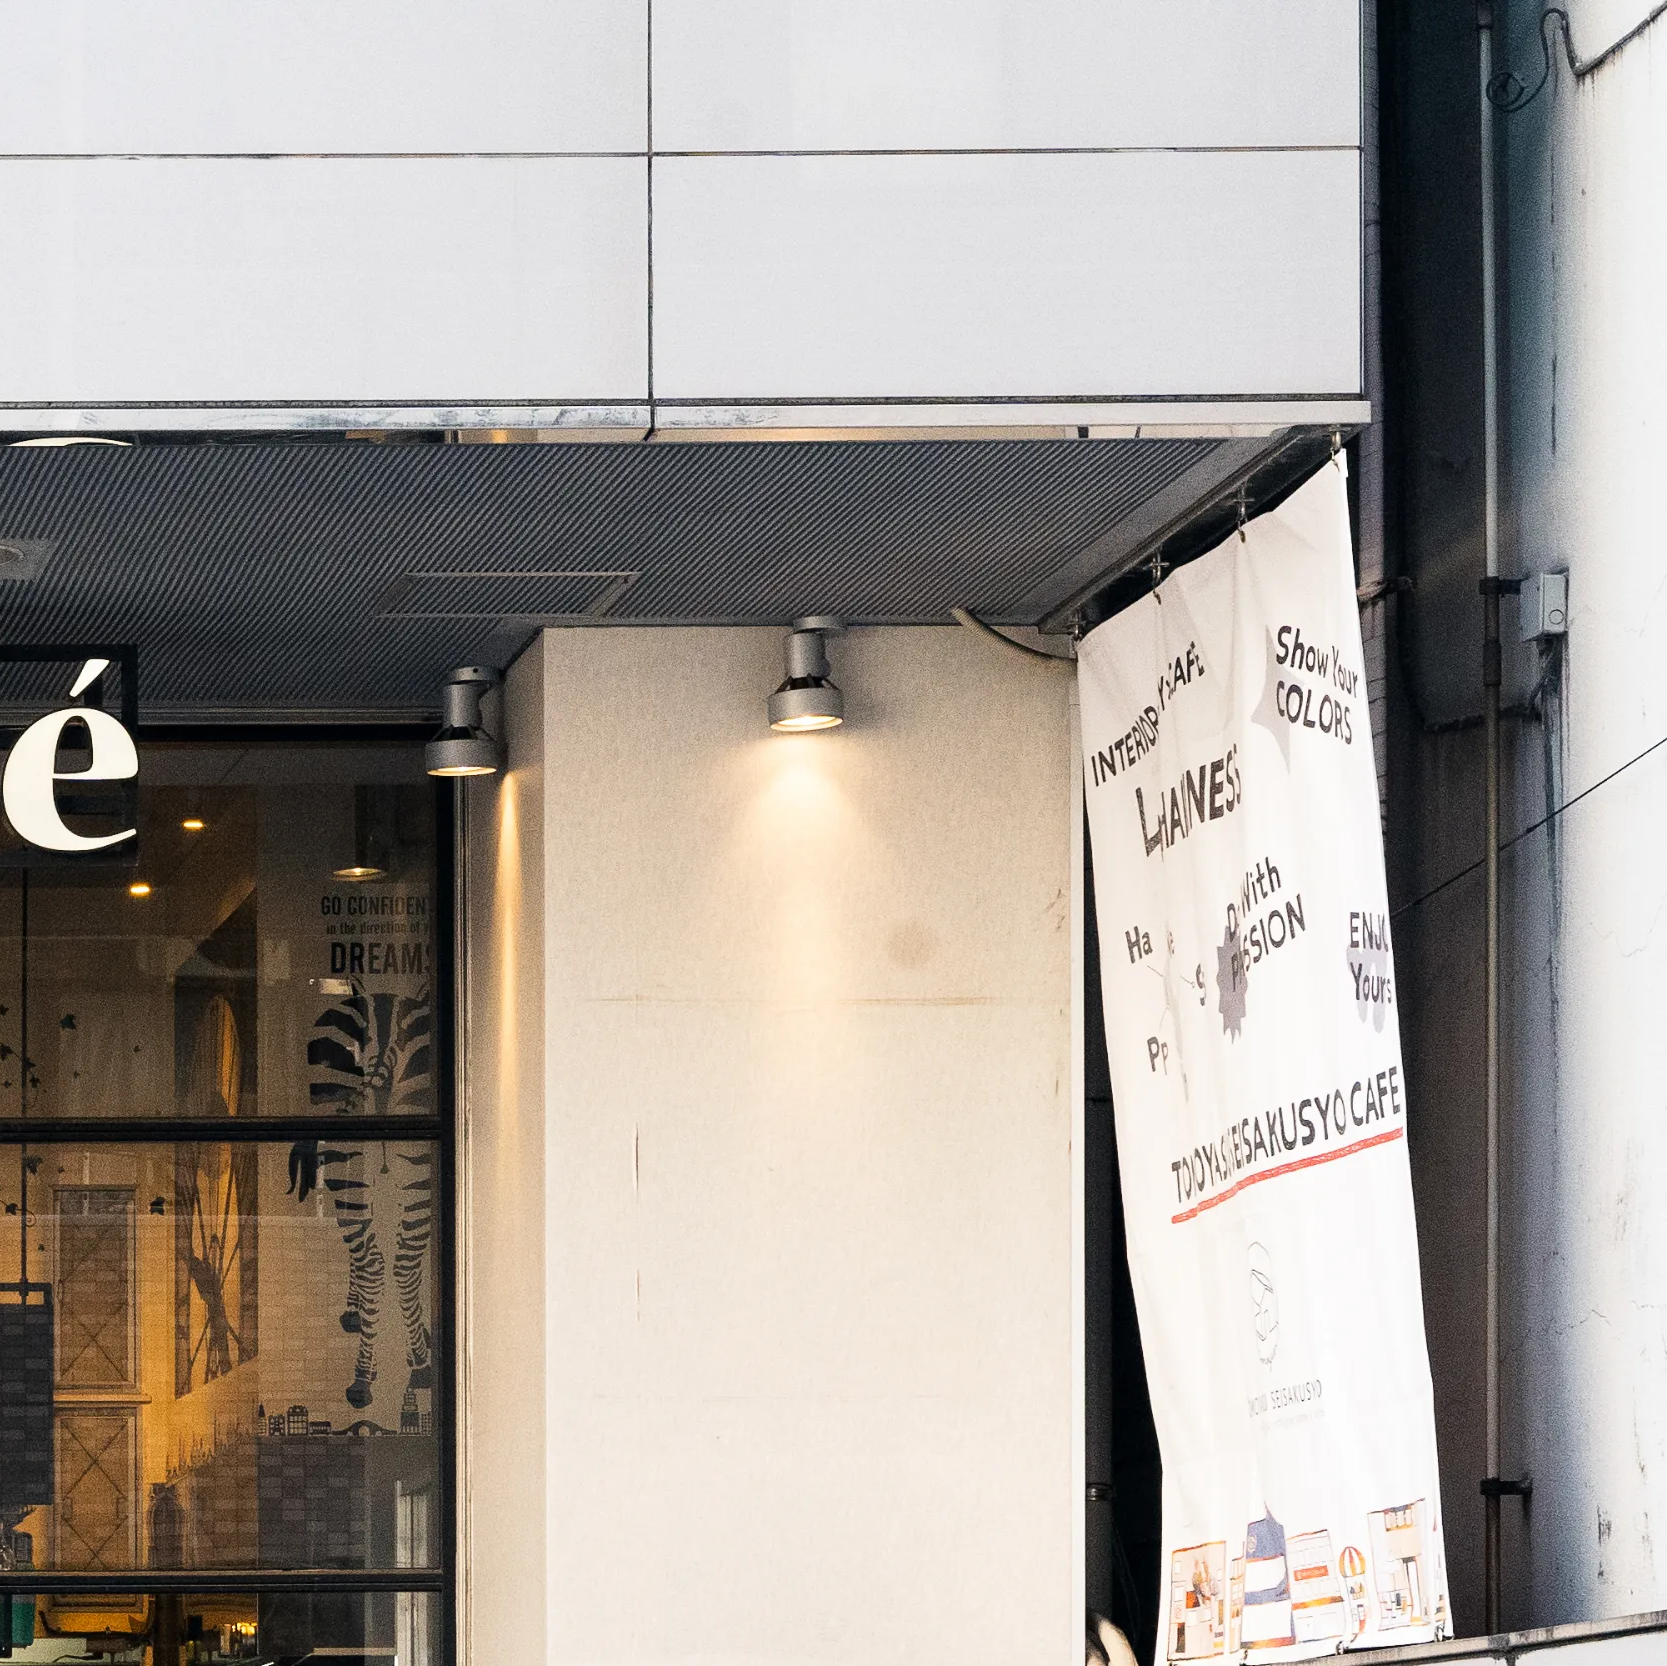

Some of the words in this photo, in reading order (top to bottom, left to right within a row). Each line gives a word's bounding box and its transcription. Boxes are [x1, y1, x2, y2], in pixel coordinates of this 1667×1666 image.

[1276, 625, 1328, 678] Show
[1331, 645, 1358, 698] Your
[1276, 680, 1352, 745] COLORS
[321, 896, 340, 915] GO
[341, 921, 356, 934] the
[1350, 1066, 1401, 1126] CAFE
